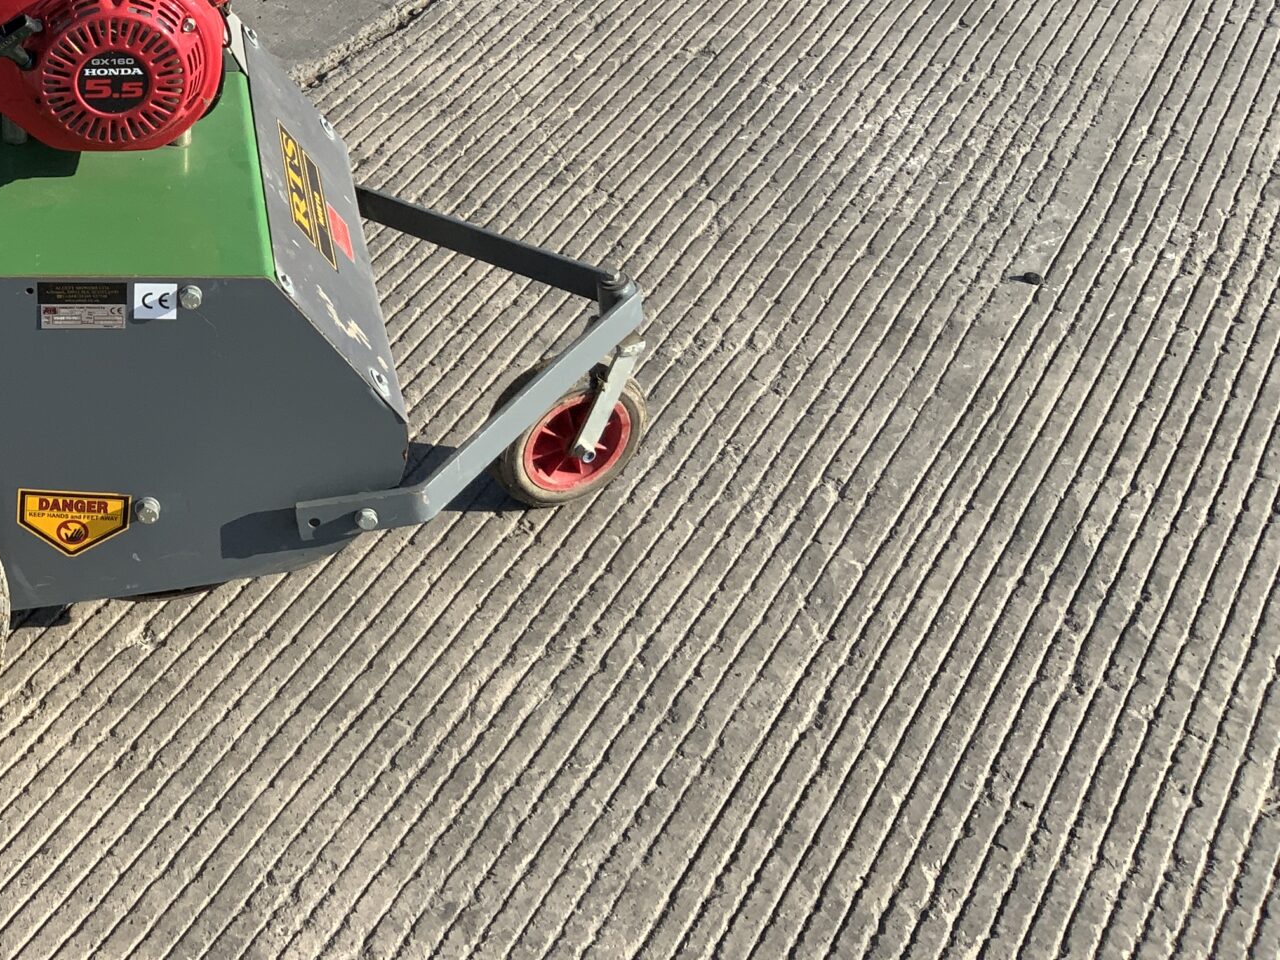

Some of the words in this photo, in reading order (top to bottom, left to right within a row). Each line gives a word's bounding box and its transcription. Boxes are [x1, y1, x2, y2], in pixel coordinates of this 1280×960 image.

[84, 67, 144, 76] HONDA
[84, 79, 143, 98] 5.5
[281, 131, 312, 236] RTS
[38, 497, 109, 514] DANGER
